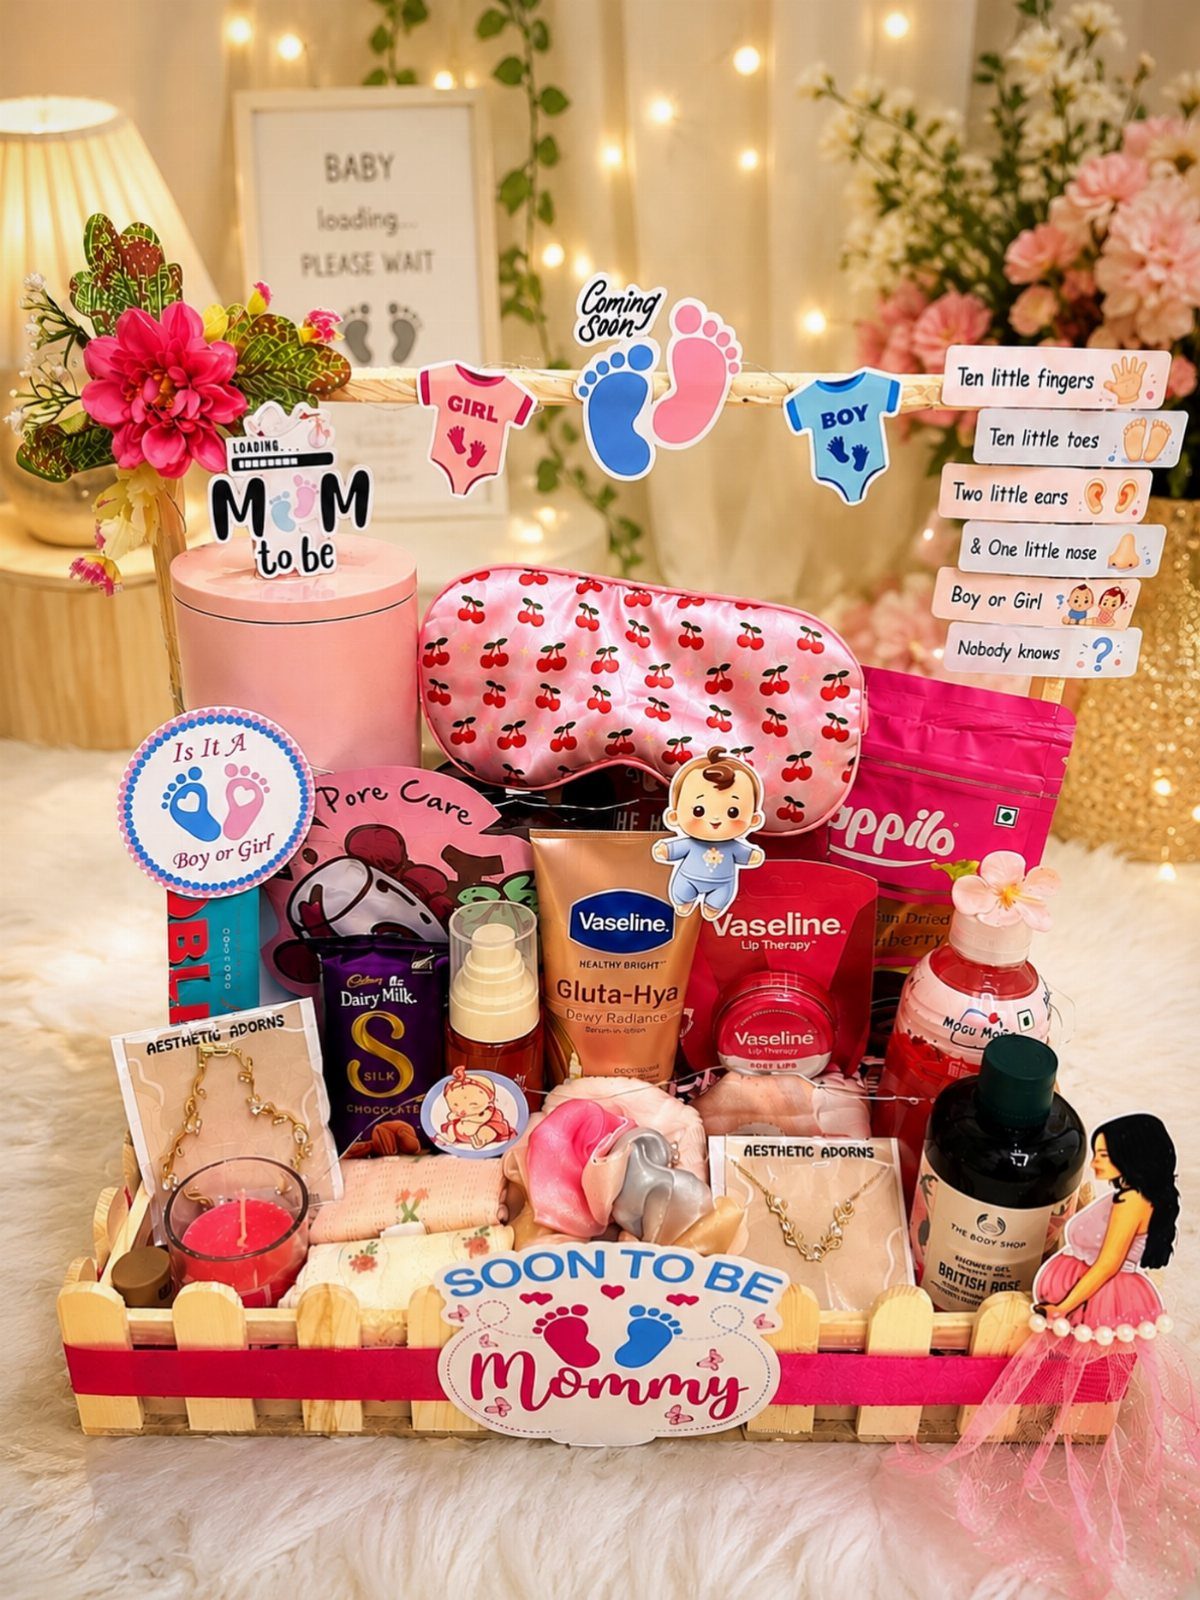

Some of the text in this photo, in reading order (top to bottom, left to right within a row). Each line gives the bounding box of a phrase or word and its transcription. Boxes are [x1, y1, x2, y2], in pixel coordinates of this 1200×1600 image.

[325, 151, 395, 184] BABY
[300, 248, 435, 278] PLEASE WAIT
[581, 279, 662, 331] Coming
[957, 366, 1095, 395] Ten little fingers
[447, 394, 498, 423] GIRL
[820, 403, 869, 430] BOY
[989, 427, 1100, 449] Ten little toes
[953, 482, 1068, 506] Two little ears
[258, 536, 335, 575] to be
[970, 537, 1097, 561] & One little nose
[951, 585, 1042, 610] Boy or Girl
[957, 640, 1012, 662] Nobody
[1018, 642, 1060, 661] knows
[172, 733, 247, 763] Is It A
[315, 779, 473, 826] Pore Care
[827, 804, 956, 857] appilo
[172, 832, 275, 871] Boy or Girl
[712, 911, 842, 938] Vaseline
[905, 911, 951, 926] Dried
[741, 939, 812, 952] Lip Therapy
[874, 929, 945, 949] nberry
[580, 960, 660, 970] HEALTHY BRIGHT
[341, 989, 380, 1009] Dairy
[556, 979, 679, 1009] Gluta-Hya
[566, 1008, 669, 1025] Dewy Radiance
[146, 1014, 285, 1056] AESTHETIC ADORNS
[735, 1030, 814, 1047] Vaseline
[346, 1010, 415, 1098] S
[363, 1071, 395, 1081] SILK
[744, 1144, 875, 1159] AESTHETIC ADORNS
[951, 1222, 1027, 1249] THE BODY SHOP
[443, 1249, 784, 1305] SOON TO BE
[938, 1261, 986, 1292] BRITISH
[470, 1349, 749, 1420] Mommy
